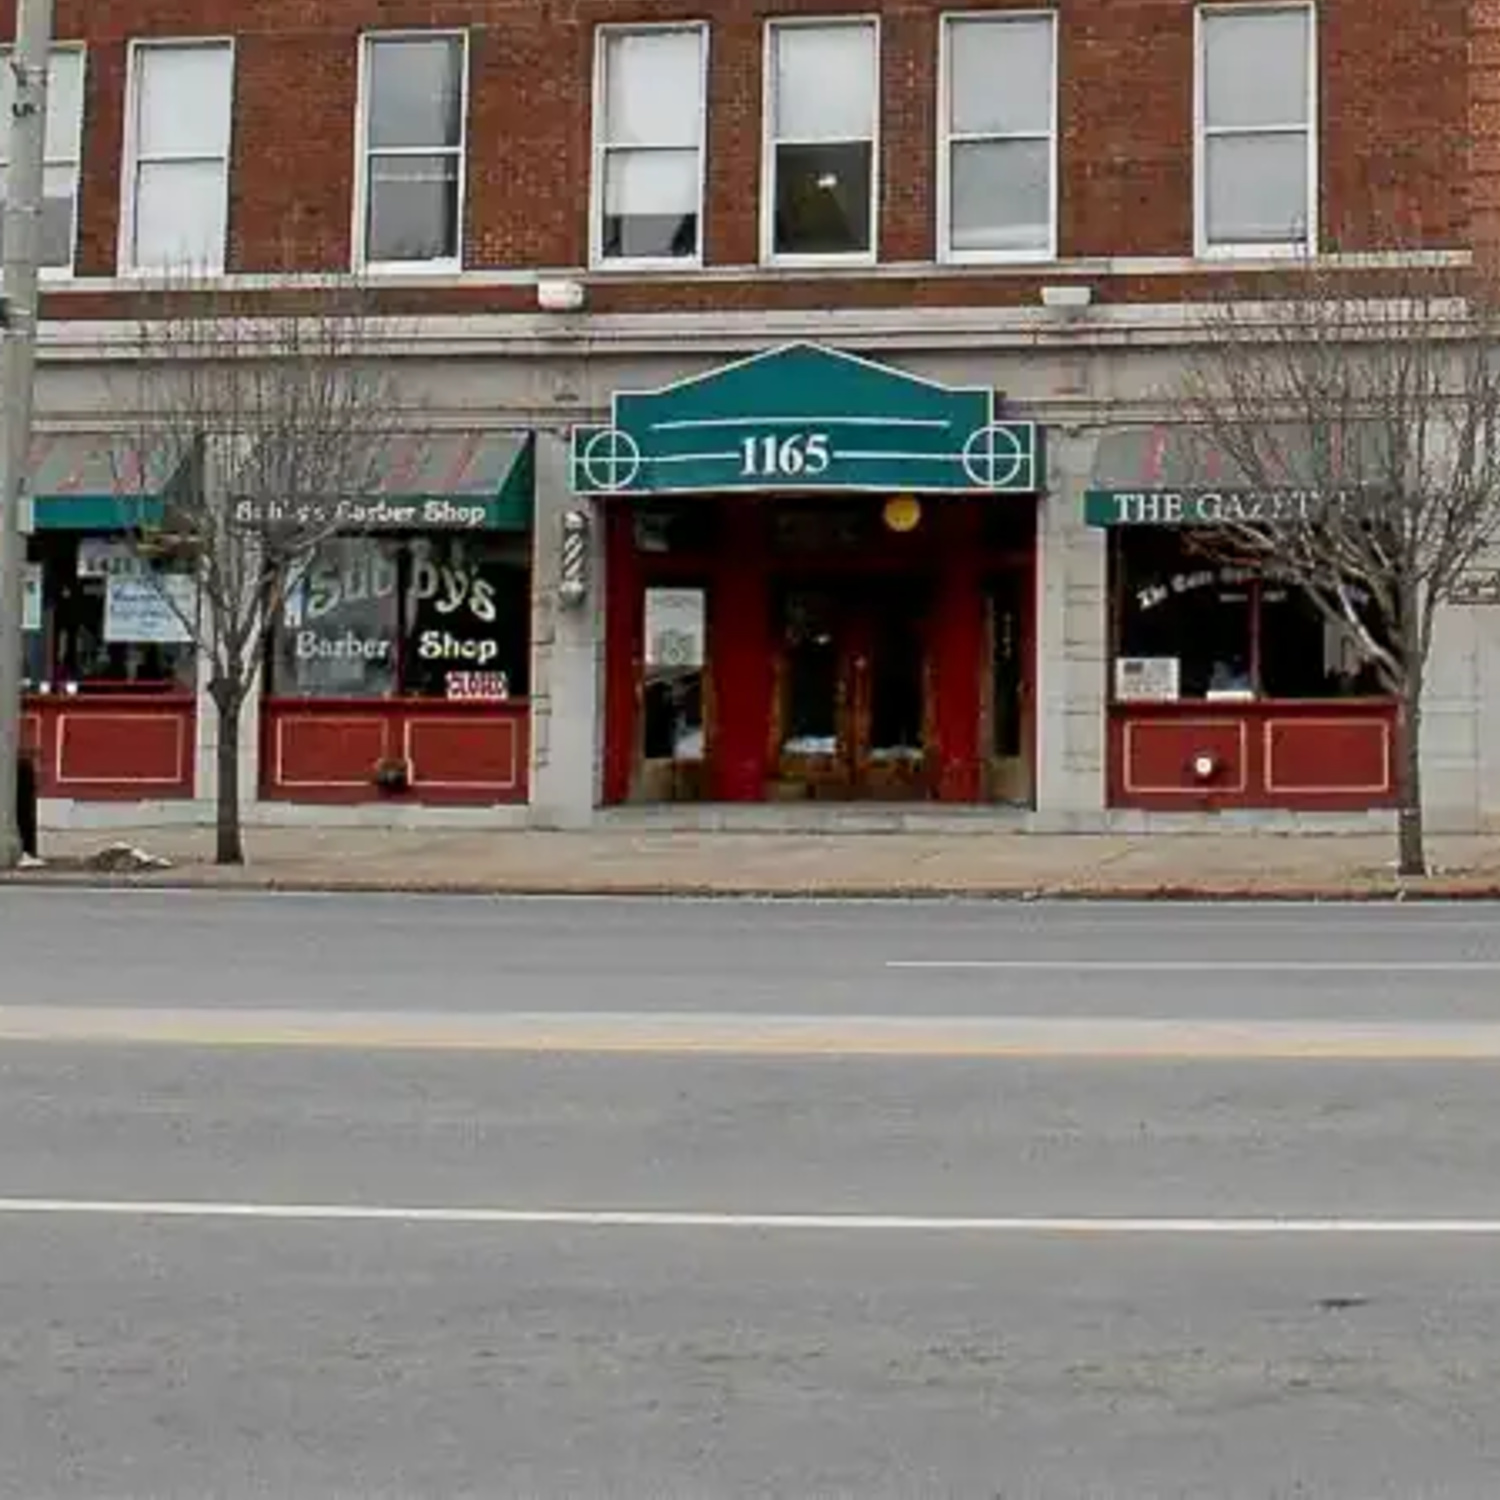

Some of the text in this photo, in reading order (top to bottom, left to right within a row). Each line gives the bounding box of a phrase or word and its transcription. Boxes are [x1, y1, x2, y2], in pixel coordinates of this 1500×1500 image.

[738, 434, 831, 476] 1165
[422, 502, 487, 527] Shop
[1112, 493, 1184, 523] THE
[296, 630, 499, 664] Barber Shop
